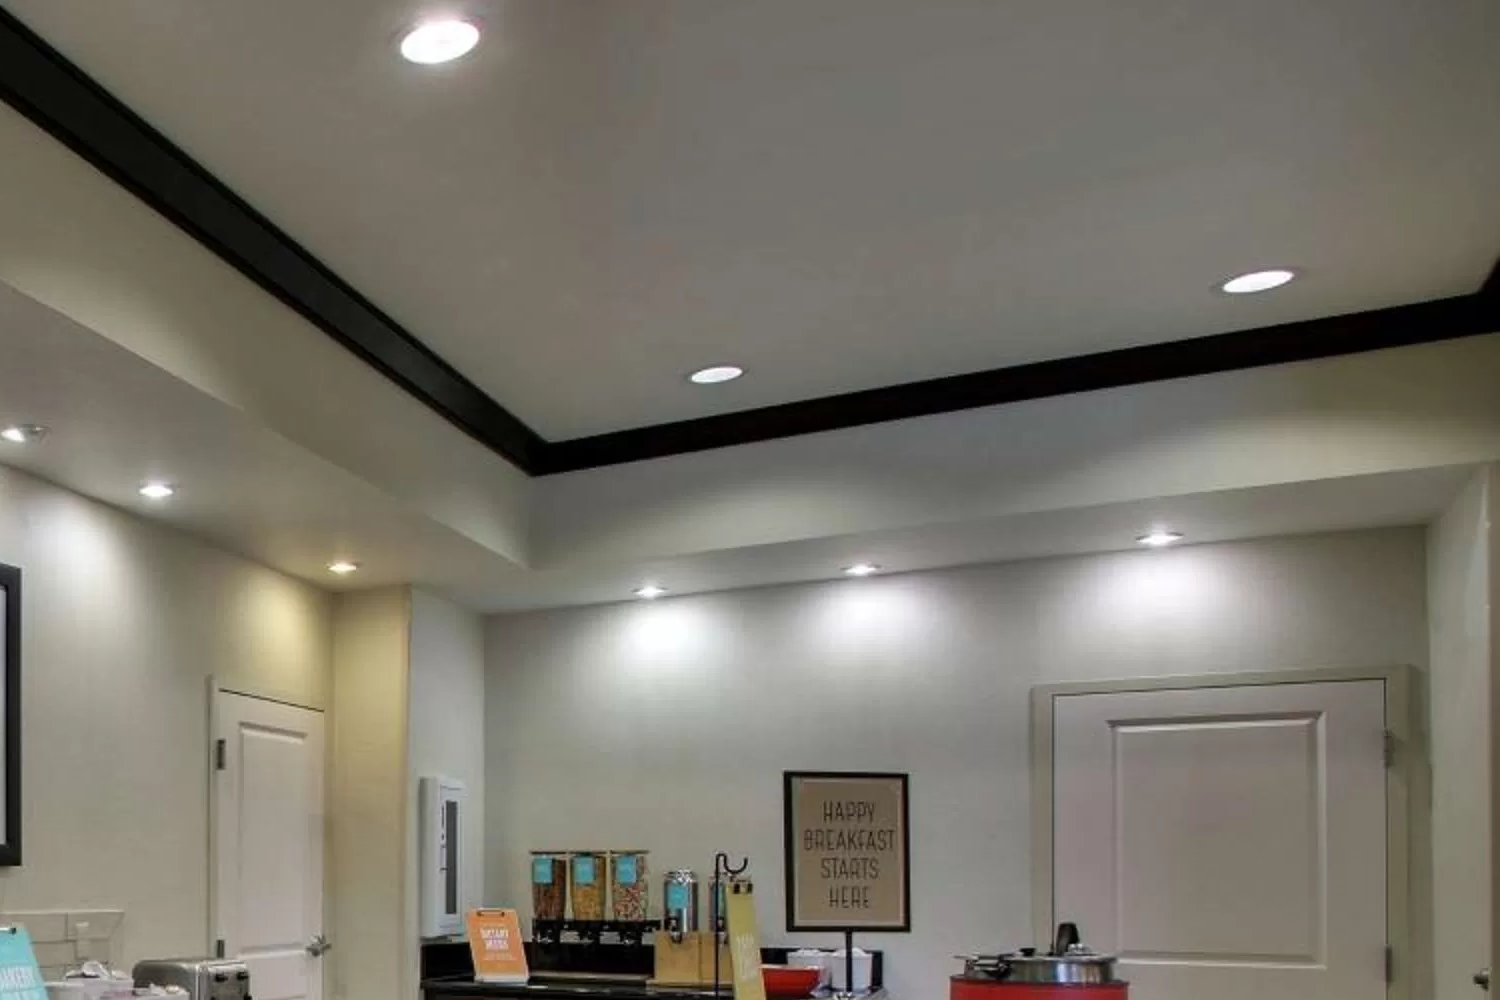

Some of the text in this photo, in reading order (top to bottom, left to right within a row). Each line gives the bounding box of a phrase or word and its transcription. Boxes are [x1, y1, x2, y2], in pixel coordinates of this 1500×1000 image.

[823, 800, 875, 822] HAPPY
[803, 828, 895, 851] BREAKFAST
[820, 857, 880, 880] STARTS
[828, 885, 869, 909] HERE
